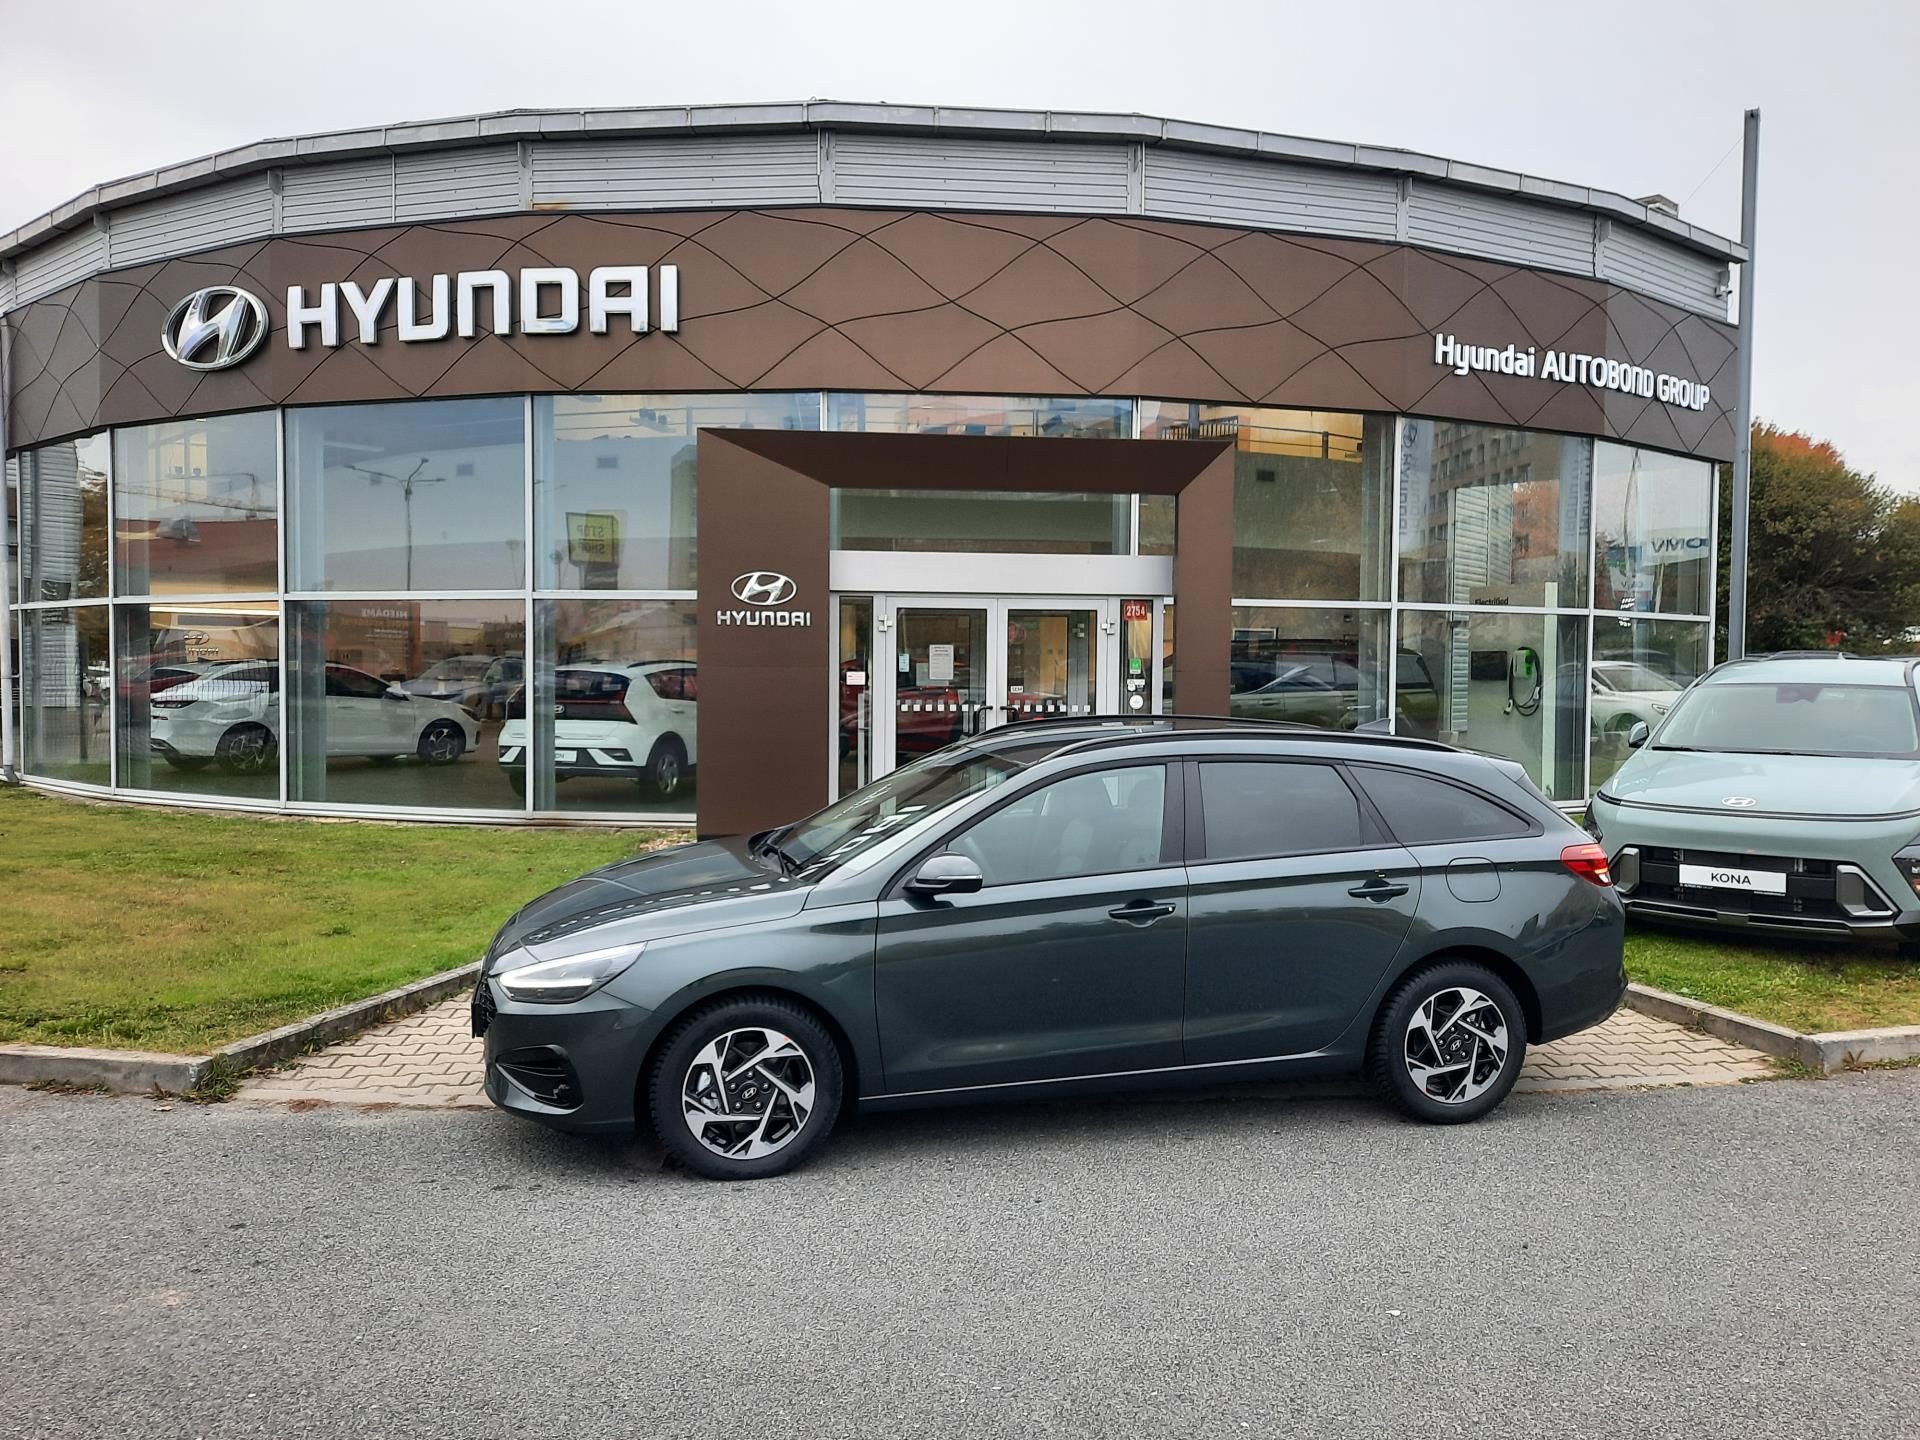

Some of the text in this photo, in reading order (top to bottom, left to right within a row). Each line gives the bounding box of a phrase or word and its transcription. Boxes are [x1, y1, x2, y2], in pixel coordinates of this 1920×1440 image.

[286, 264, 679, 349] HYUNDAI
[1435, 334, 1710, 411] Hyundai AUTOBOND GROUP
[717, 610, 812, 627] HYUNDAI
[1126, 605, 1146, 617] 2754
[1711, 872, 1751, 885] KONA
